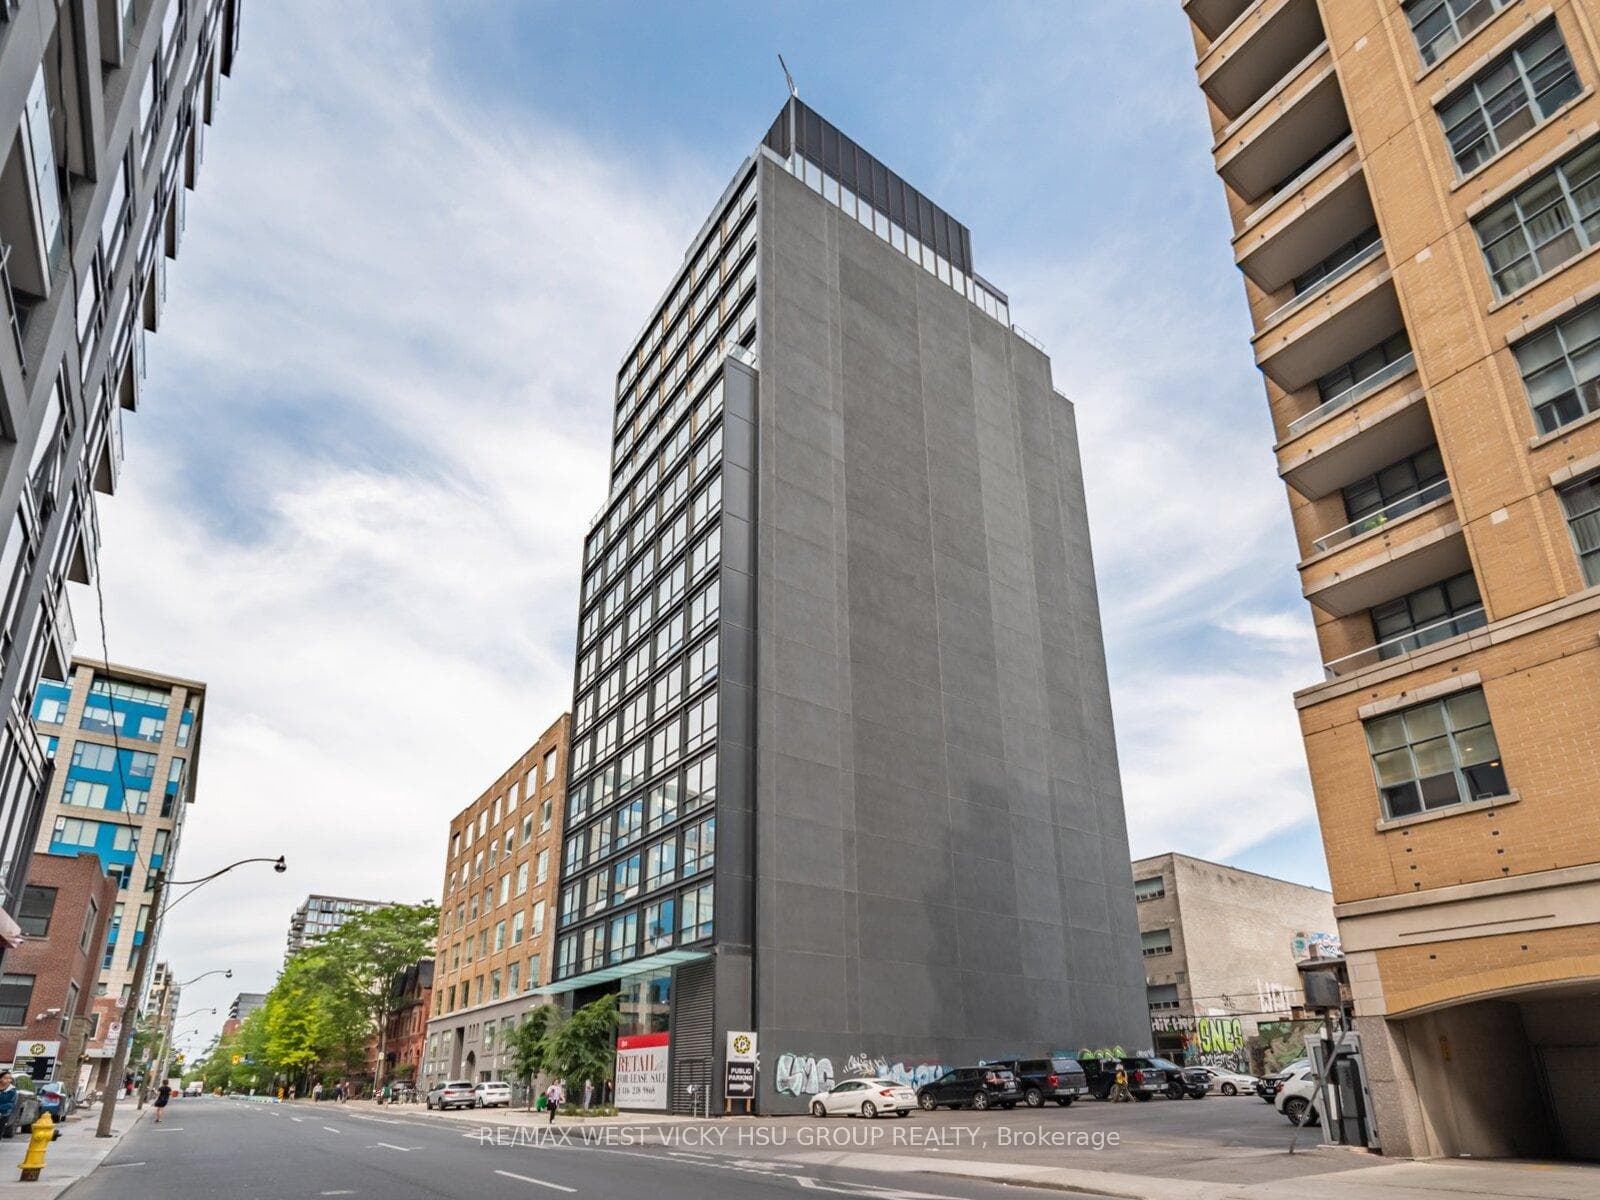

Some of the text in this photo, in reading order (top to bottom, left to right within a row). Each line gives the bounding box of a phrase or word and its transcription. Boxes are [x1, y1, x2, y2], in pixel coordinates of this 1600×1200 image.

[618, 1054, 657, 1072] RETAIL
[617, 1073, 667, 1083] FOR LEASE SALE
